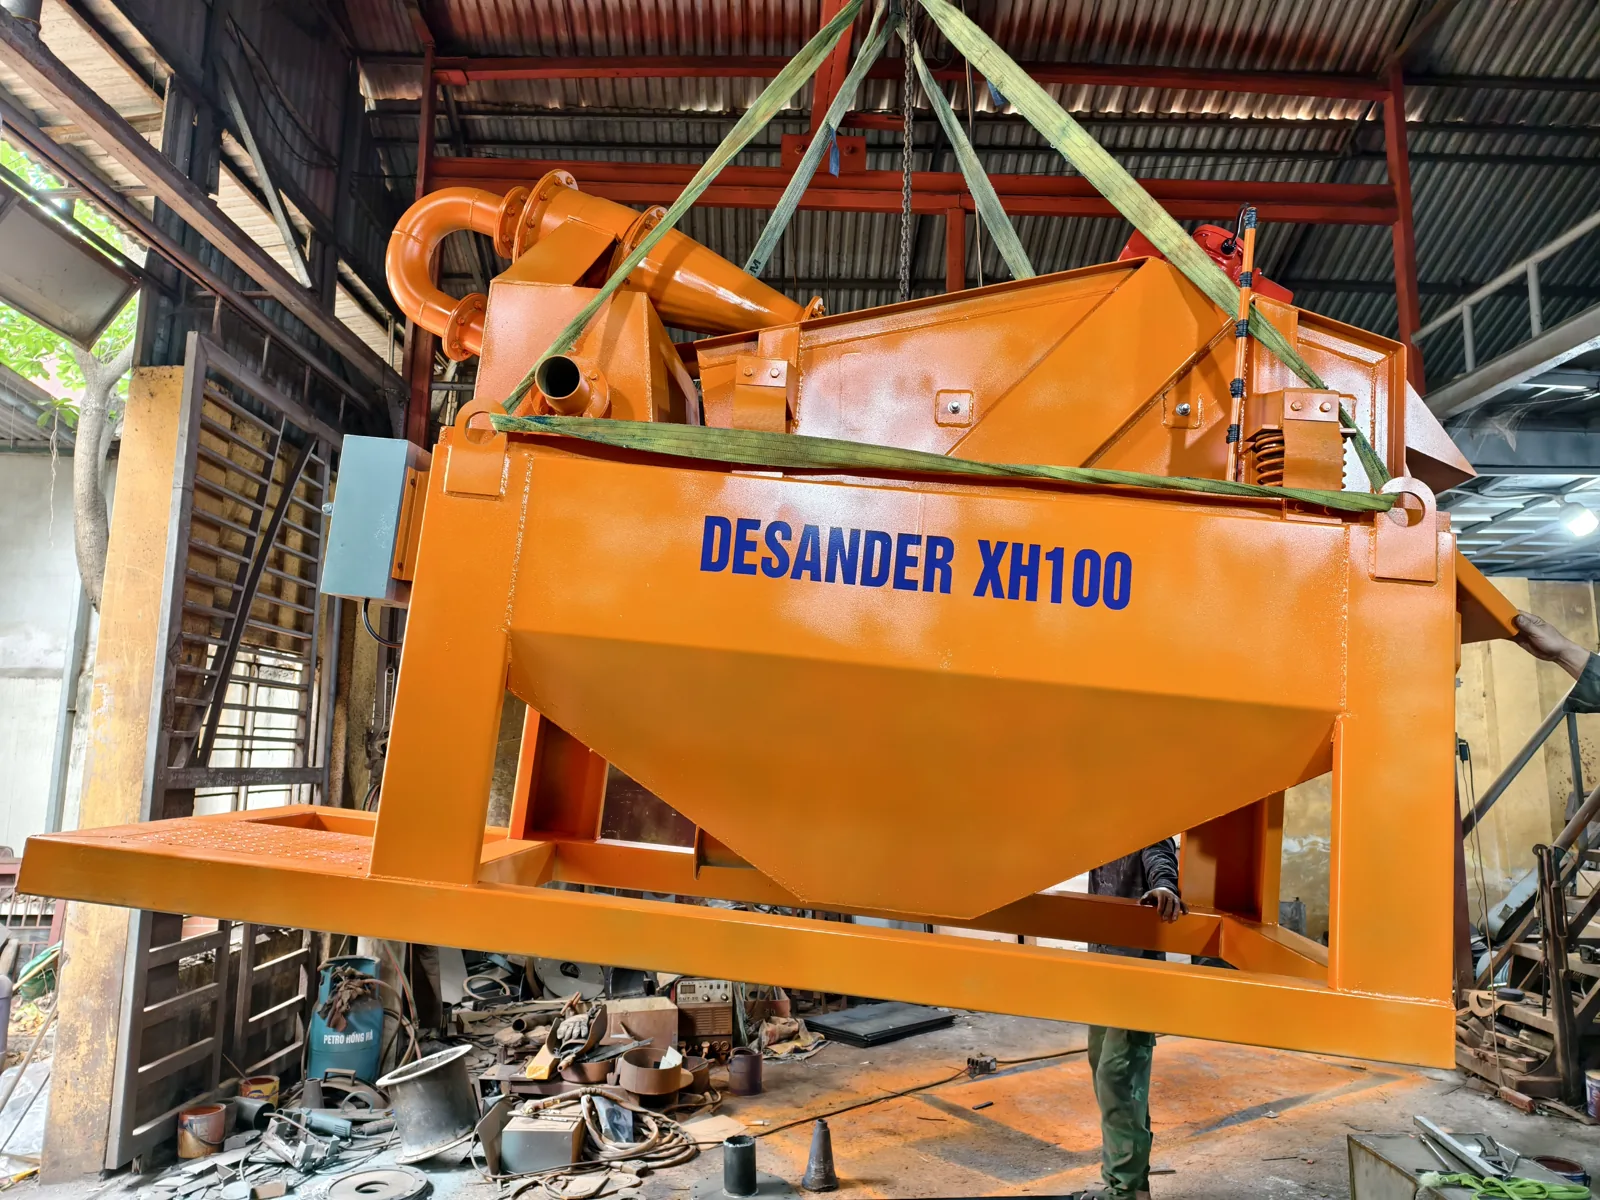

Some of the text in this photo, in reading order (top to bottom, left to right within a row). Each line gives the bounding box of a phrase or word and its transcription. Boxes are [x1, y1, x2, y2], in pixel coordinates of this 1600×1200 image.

[700, 516, 1133, 611] DESANDER XH100
[323, 1034, 345, 1044] PETRO
